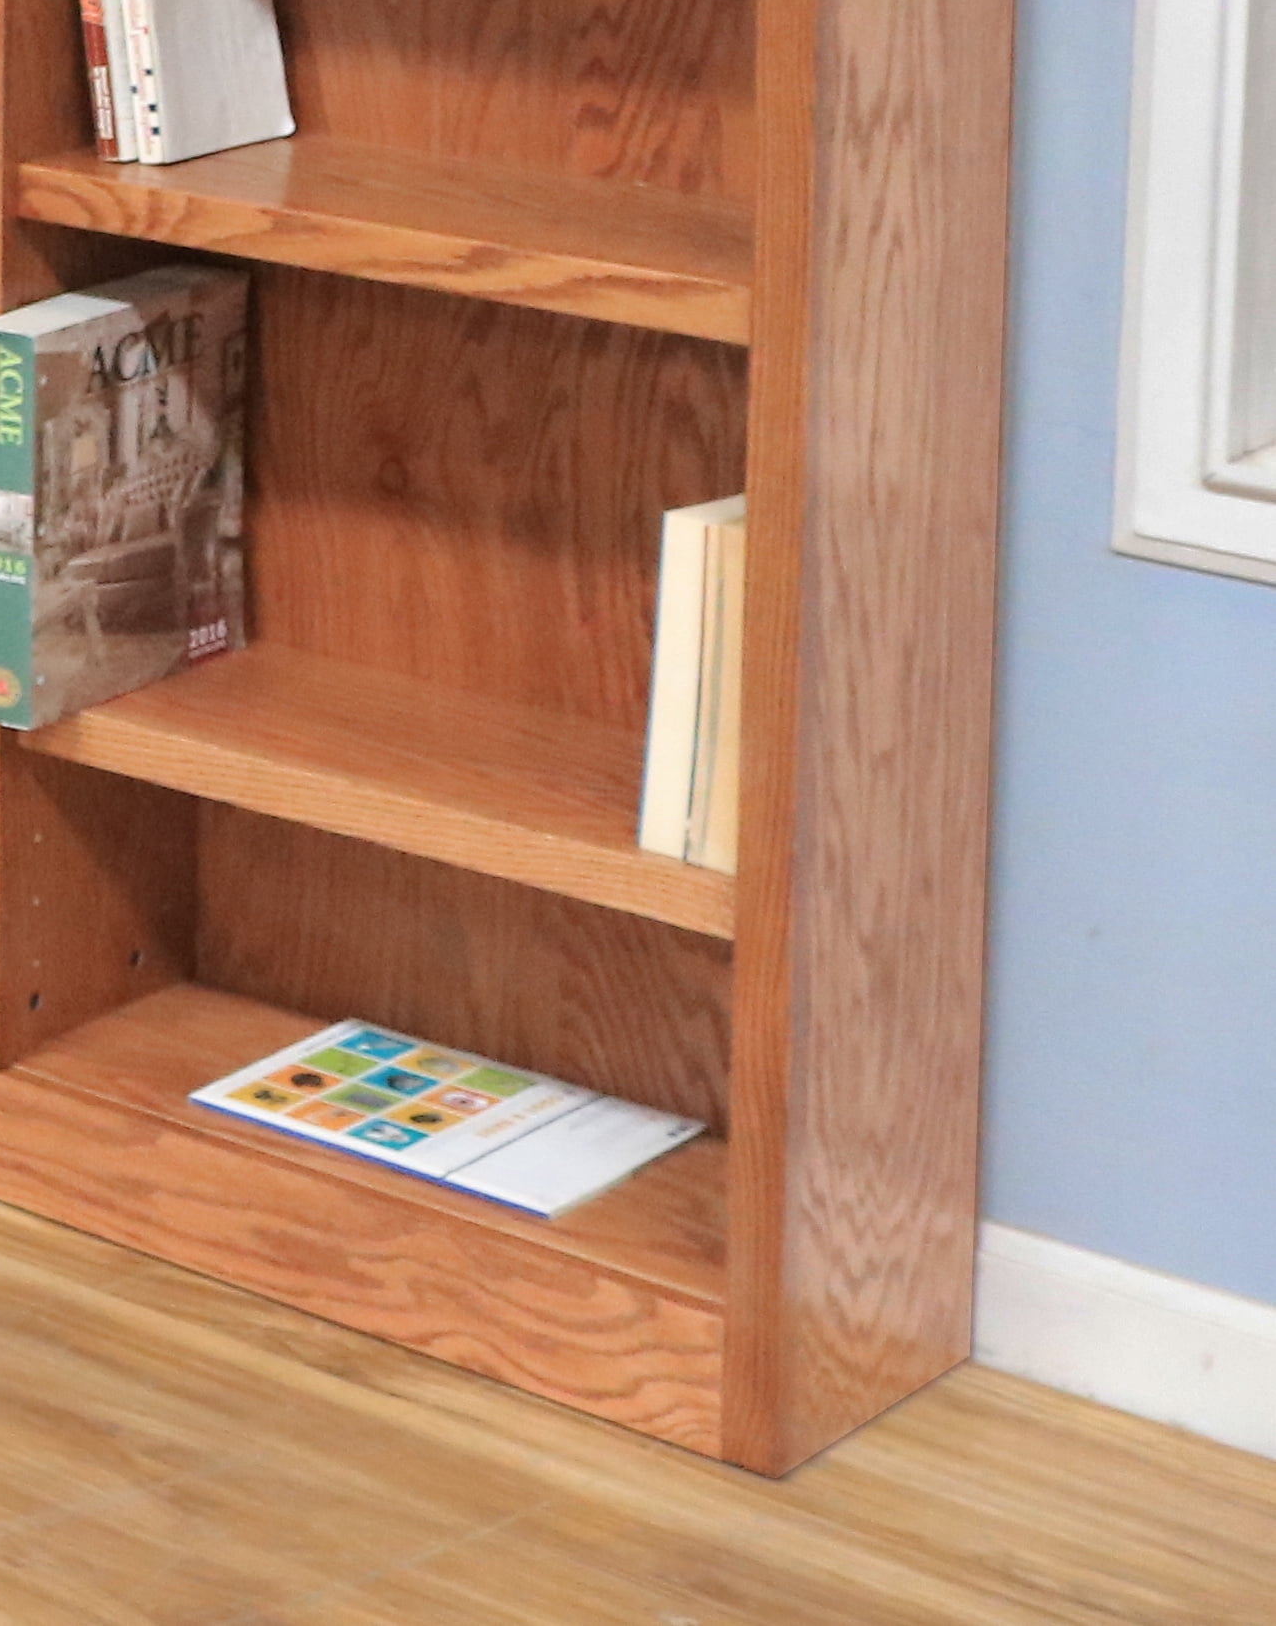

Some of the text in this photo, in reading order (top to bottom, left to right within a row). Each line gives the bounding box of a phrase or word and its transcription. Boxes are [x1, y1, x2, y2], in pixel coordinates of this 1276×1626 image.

[86, 309, 204, 395] ACME
[0, 344, 25, 447] ACME
[188, 618, 228, 649] 2016
